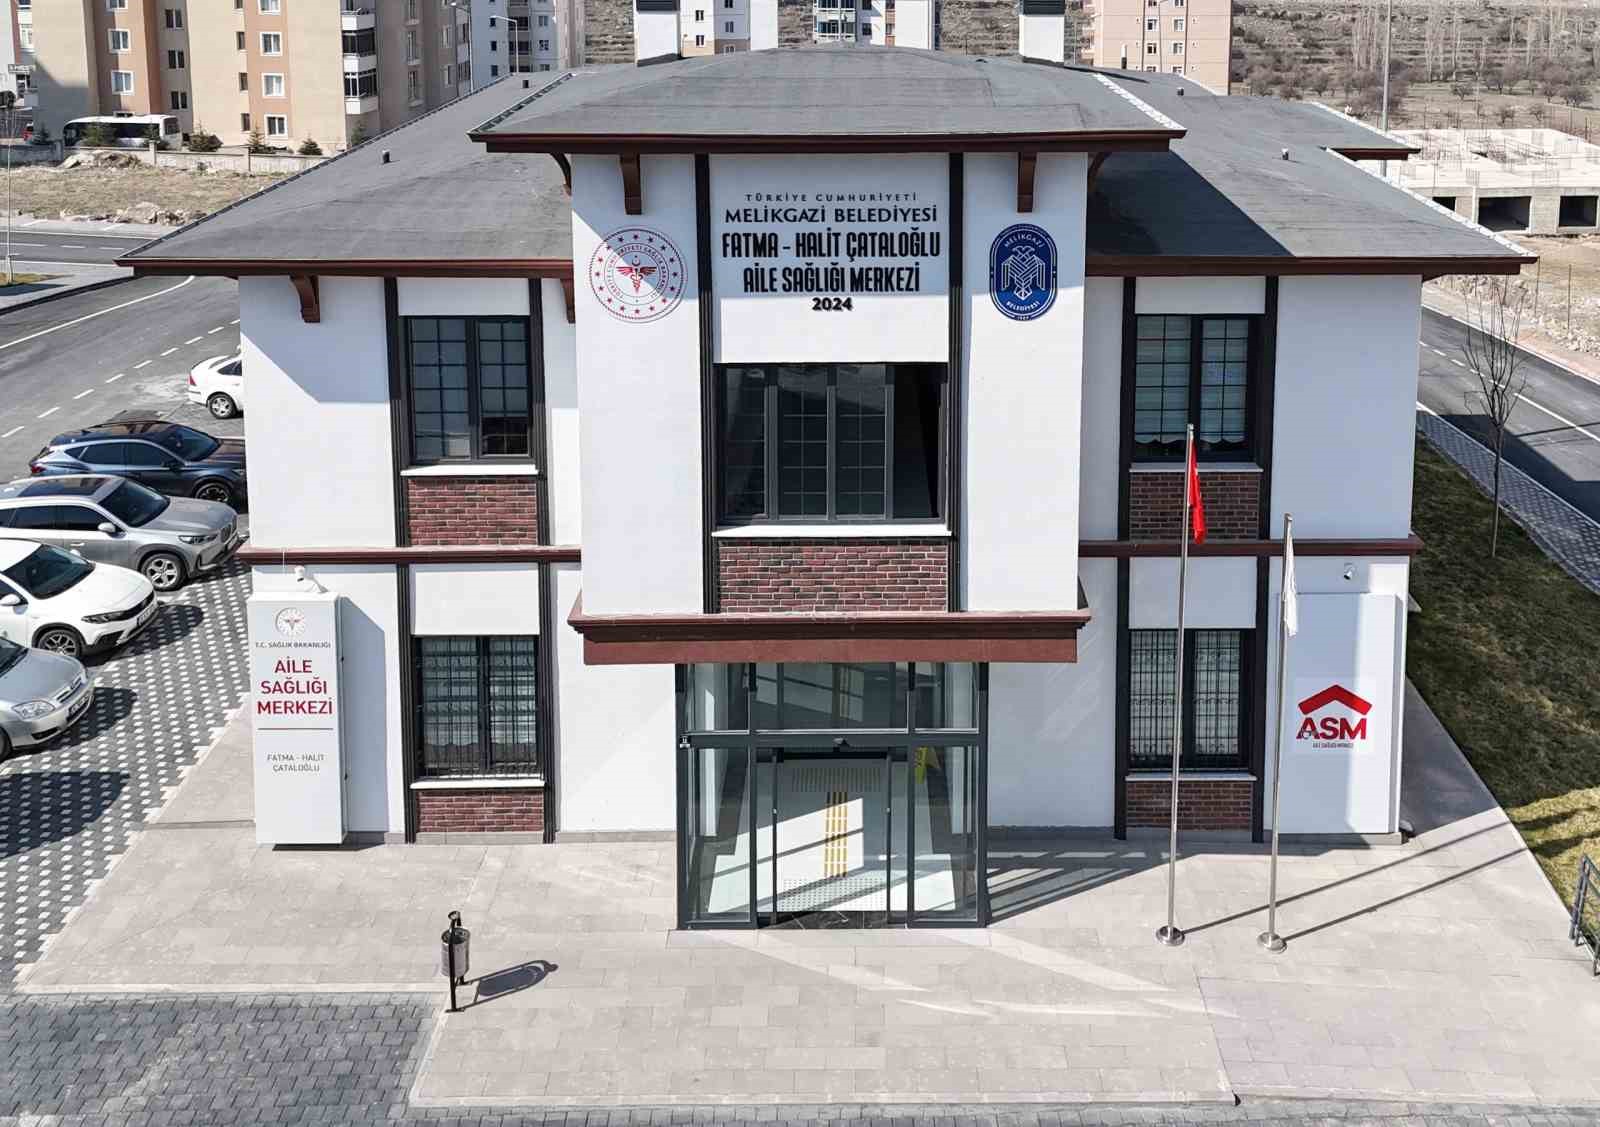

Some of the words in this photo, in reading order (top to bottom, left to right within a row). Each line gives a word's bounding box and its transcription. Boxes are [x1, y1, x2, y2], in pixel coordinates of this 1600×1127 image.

[745, 192, 807, 201] TÜRKİYE
[815, 192, 917, 201] CUMHURİYETİ
[725, 205, 825, 223] MELİKGAZİ
[834, 204, 937, 223] BELEDİYESİ
[722, 232, 778, 258] FATMA
[795, 227, 841, 258] HALİT
[846, 227, 940, 262] ÇATALOĞLU
[743, 262, 778, 292] AİLE
[782, 262, 845, 292] SAĞLIĞI
[850, 262, 920, 292] MERKEZİ
[812, 297, 853, 311] 2024
[274, 656, 312, 673] AİLE
[260, 677, 327, 695] SAĞLIĞI
[257, 697, 333, 715] MERKEZİ
[1296, 717, 1367, 740] ASM
